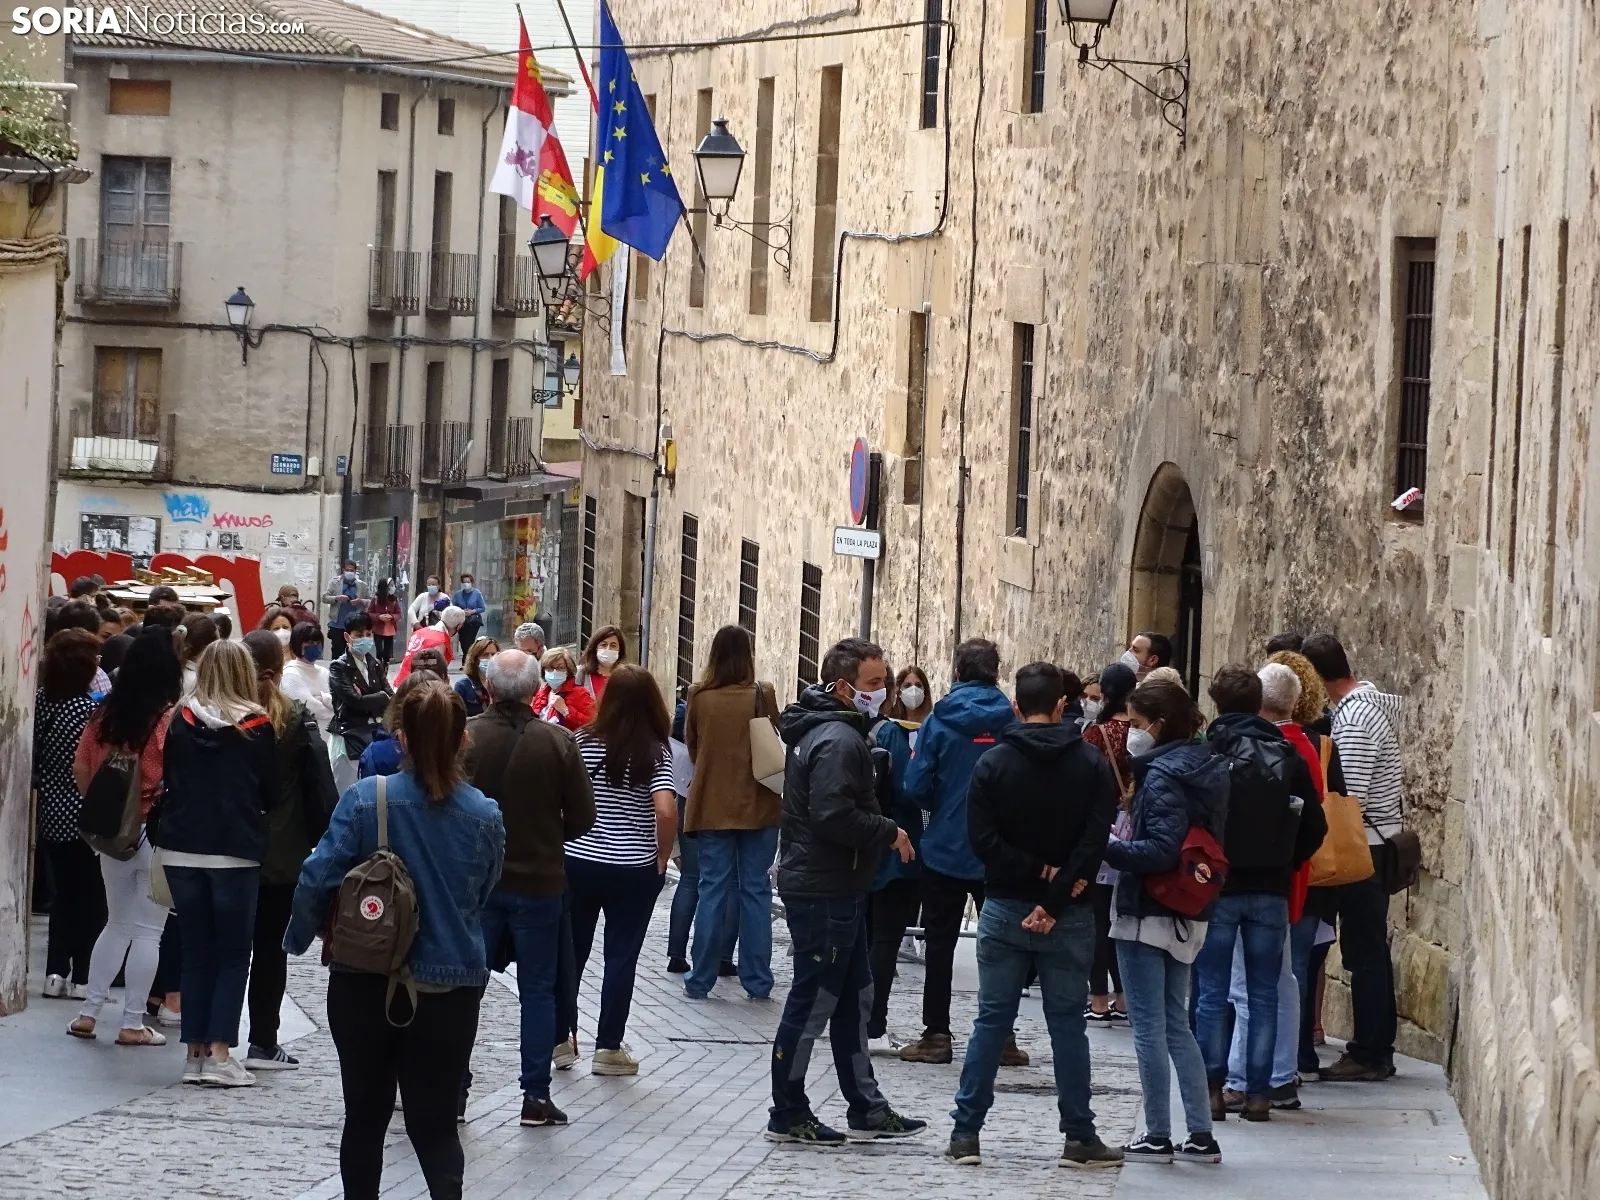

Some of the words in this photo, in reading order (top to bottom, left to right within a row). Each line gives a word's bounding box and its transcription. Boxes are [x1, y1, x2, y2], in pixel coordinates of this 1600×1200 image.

[836, 536, 843, 544] EN
[844, 537, 856, 546] TODA
[856, 539, 863, 547] LA
[863, 540, 878, 548] PLAZA
